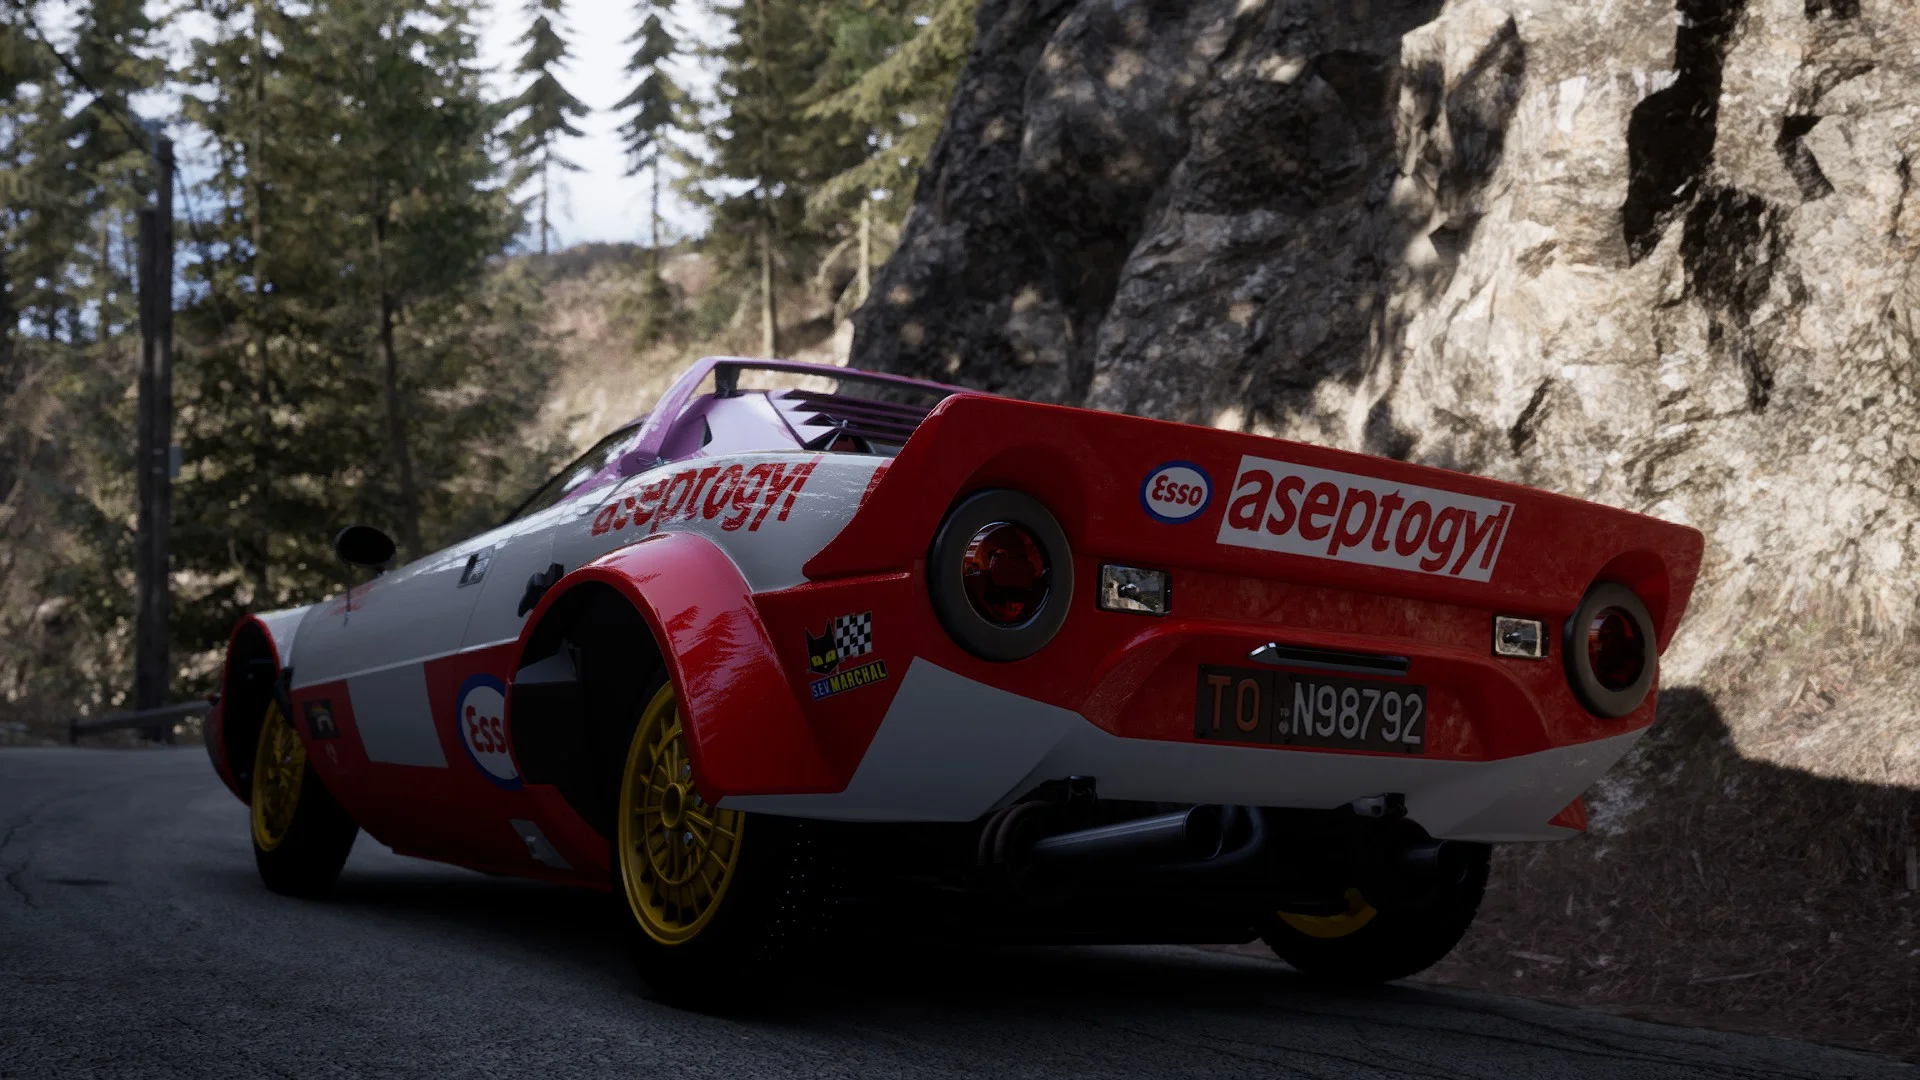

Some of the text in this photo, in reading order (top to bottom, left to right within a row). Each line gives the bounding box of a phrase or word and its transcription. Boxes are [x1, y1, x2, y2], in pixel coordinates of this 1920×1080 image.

[591, 463, 817, 536] aseptogyl
[1152, 475, 1203, 507] Esso
[1228, 469, 1511, 575] aseptogyl
[829, 662, 887, 693] MARCHAL
[466, 705, 507, 753] Ess
[1207, 674, 1260, 732] TO
[1292, 681, 1423, 745] N98792
